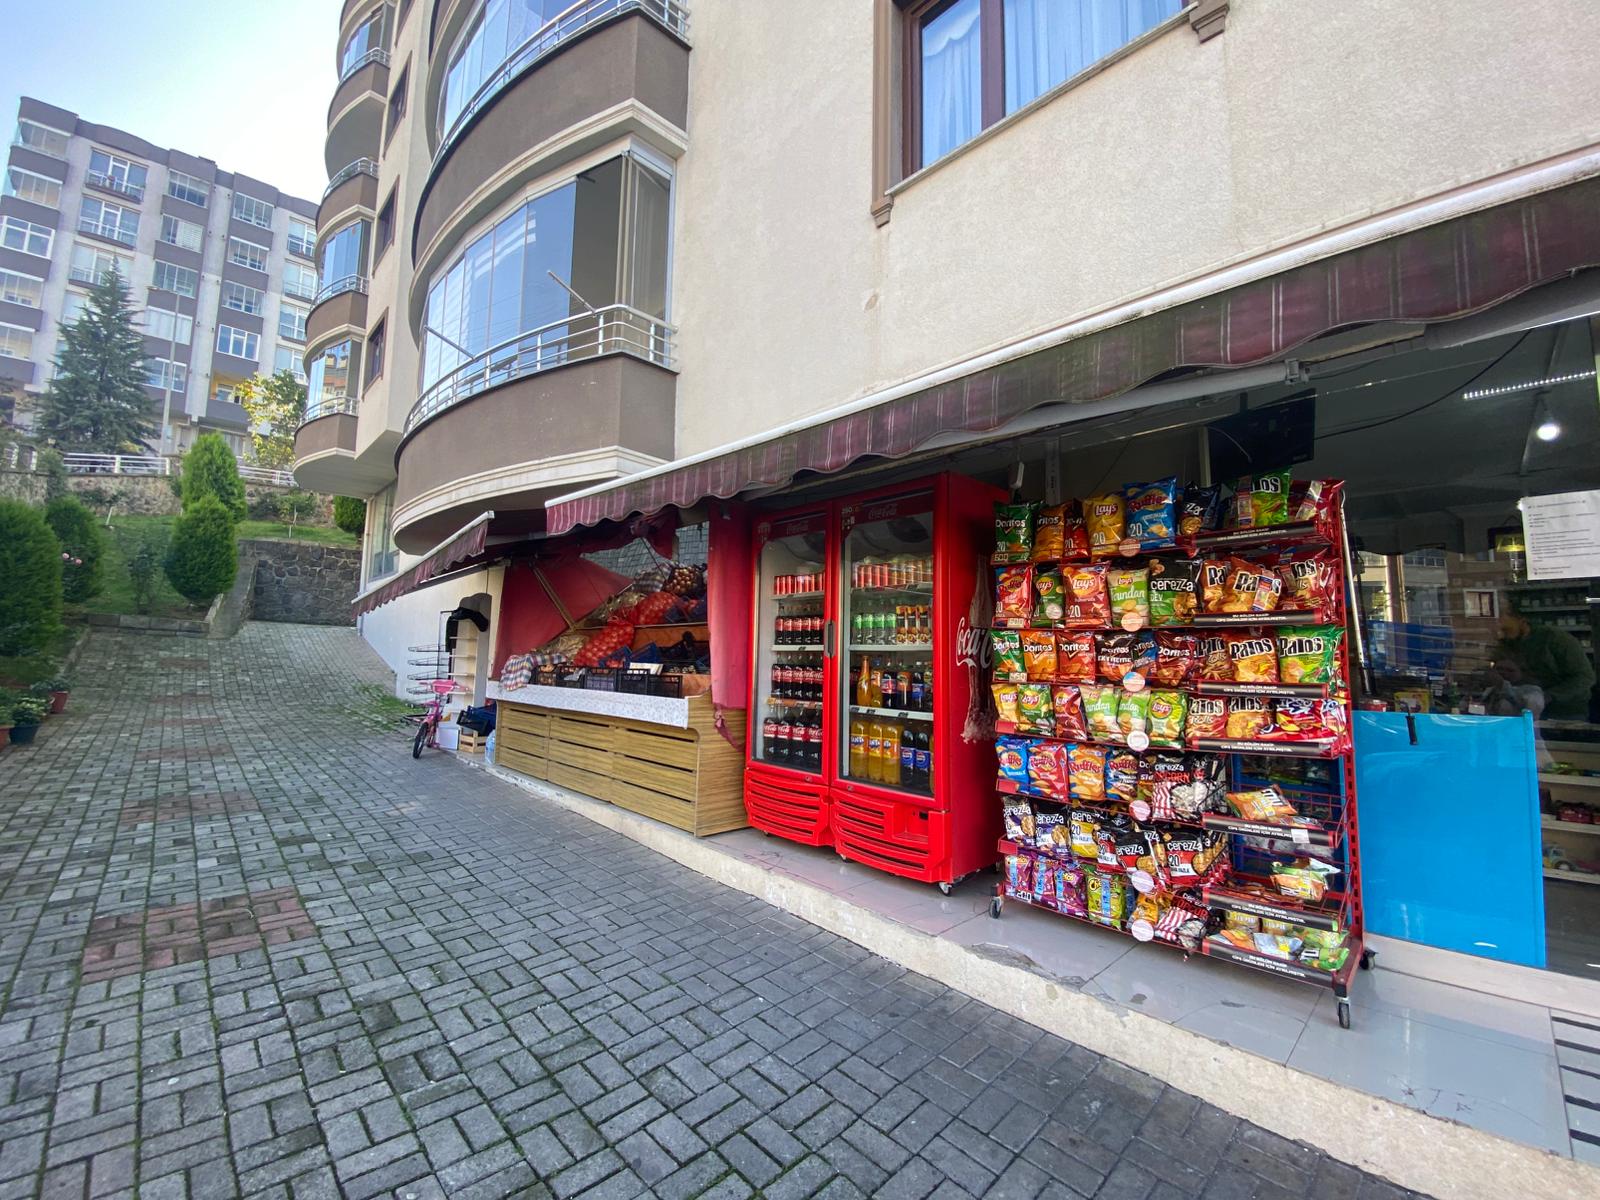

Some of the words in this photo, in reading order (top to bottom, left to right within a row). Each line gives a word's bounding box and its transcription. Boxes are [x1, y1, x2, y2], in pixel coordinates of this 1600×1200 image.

[1095, 504, 1117, 516] Lay's
[1129, 522, 1143, 537] 20
[1093, 532, 1106, 546] 20
[1073, 578, 1096, 589] Lay's
[1069, 604, 1081, 618] 20
[1023, 643, 1053, 652] Doritos
[1230, 638, 1275, 661] Patos
[1280, 636, 1325, 658] Patos
[1070, 759, 1103, 775] Ruffles
[1167, 841, 1203, 852] cerezza
[1168, 854, 1180, 866] 20
